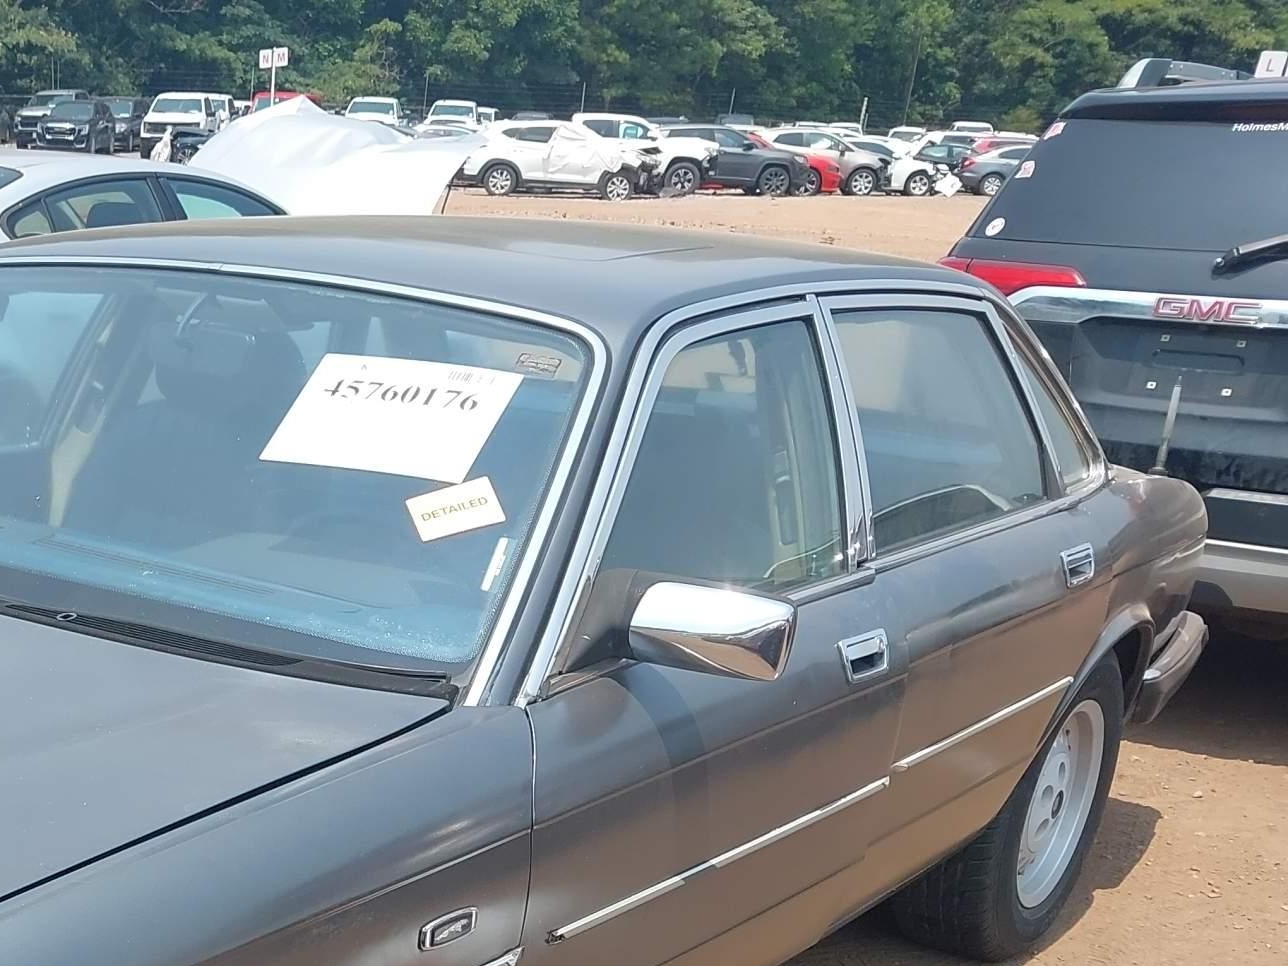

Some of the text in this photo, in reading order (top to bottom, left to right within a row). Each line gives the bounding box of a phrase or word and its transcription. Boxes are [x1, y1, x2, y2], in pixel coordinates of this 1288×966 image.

[1265, 58, 1274, 73] L
[1152, 296, 1263, 325] GMC
[323, 378, 480, 411] 45760176
[420, 495, 489, 523] DETAILED
